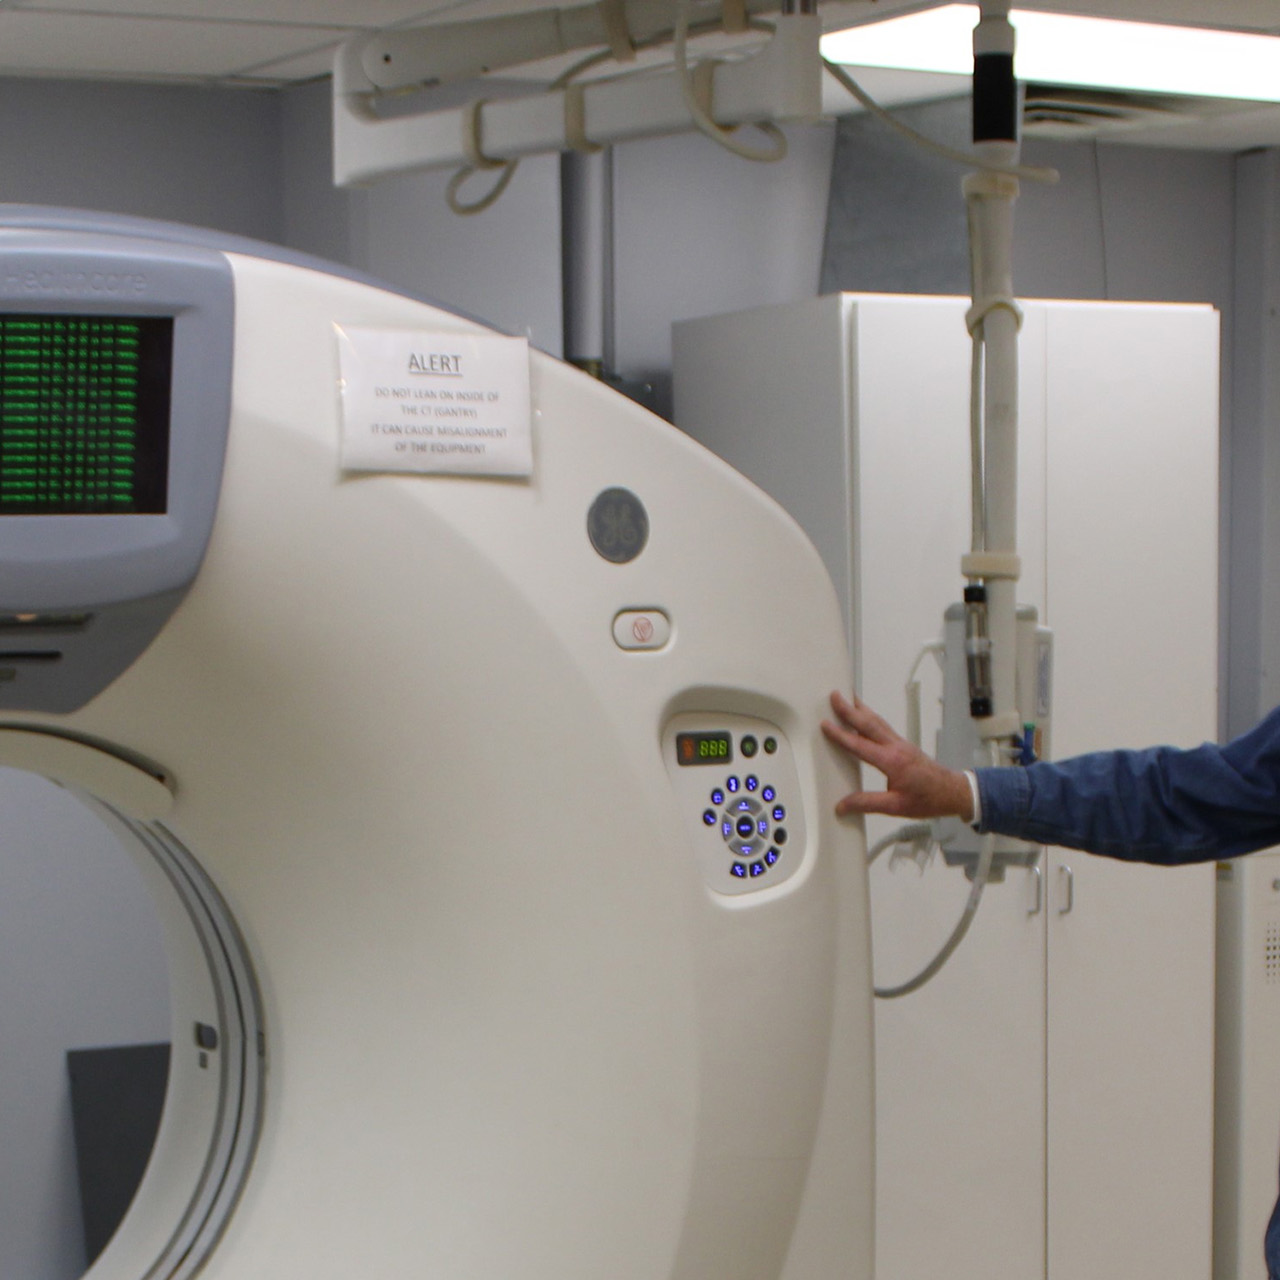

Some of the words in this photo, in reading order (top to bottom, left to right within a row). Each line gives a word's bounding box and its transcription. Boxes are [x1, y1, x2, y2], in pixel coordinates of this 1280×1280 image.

[408, 353, 462, 373] ALERT
[374, 387, 390, 399] DO
[392, 387, 411, 399] NOT
[414, 388, 437, 400] LEAN
[439, 389, 454, 401] ON
[457, 390, 485, 402] INSIDE
[487, 391, 500, 403] OF
[401, 404, 418, 416] THE
[420, 405, 432, 416] CT
[371, 423, 380, 434] IT
[382, 424, 402, 435] CAN
[404, 424, 434, 436] CAUSE
[437, 425, 507, 438] MISALIGNMENT
[395, 441, 408, 452] OF
[411, 442, 427, 453] THE
[430, 443, 486, 454] EQUIPMENT
